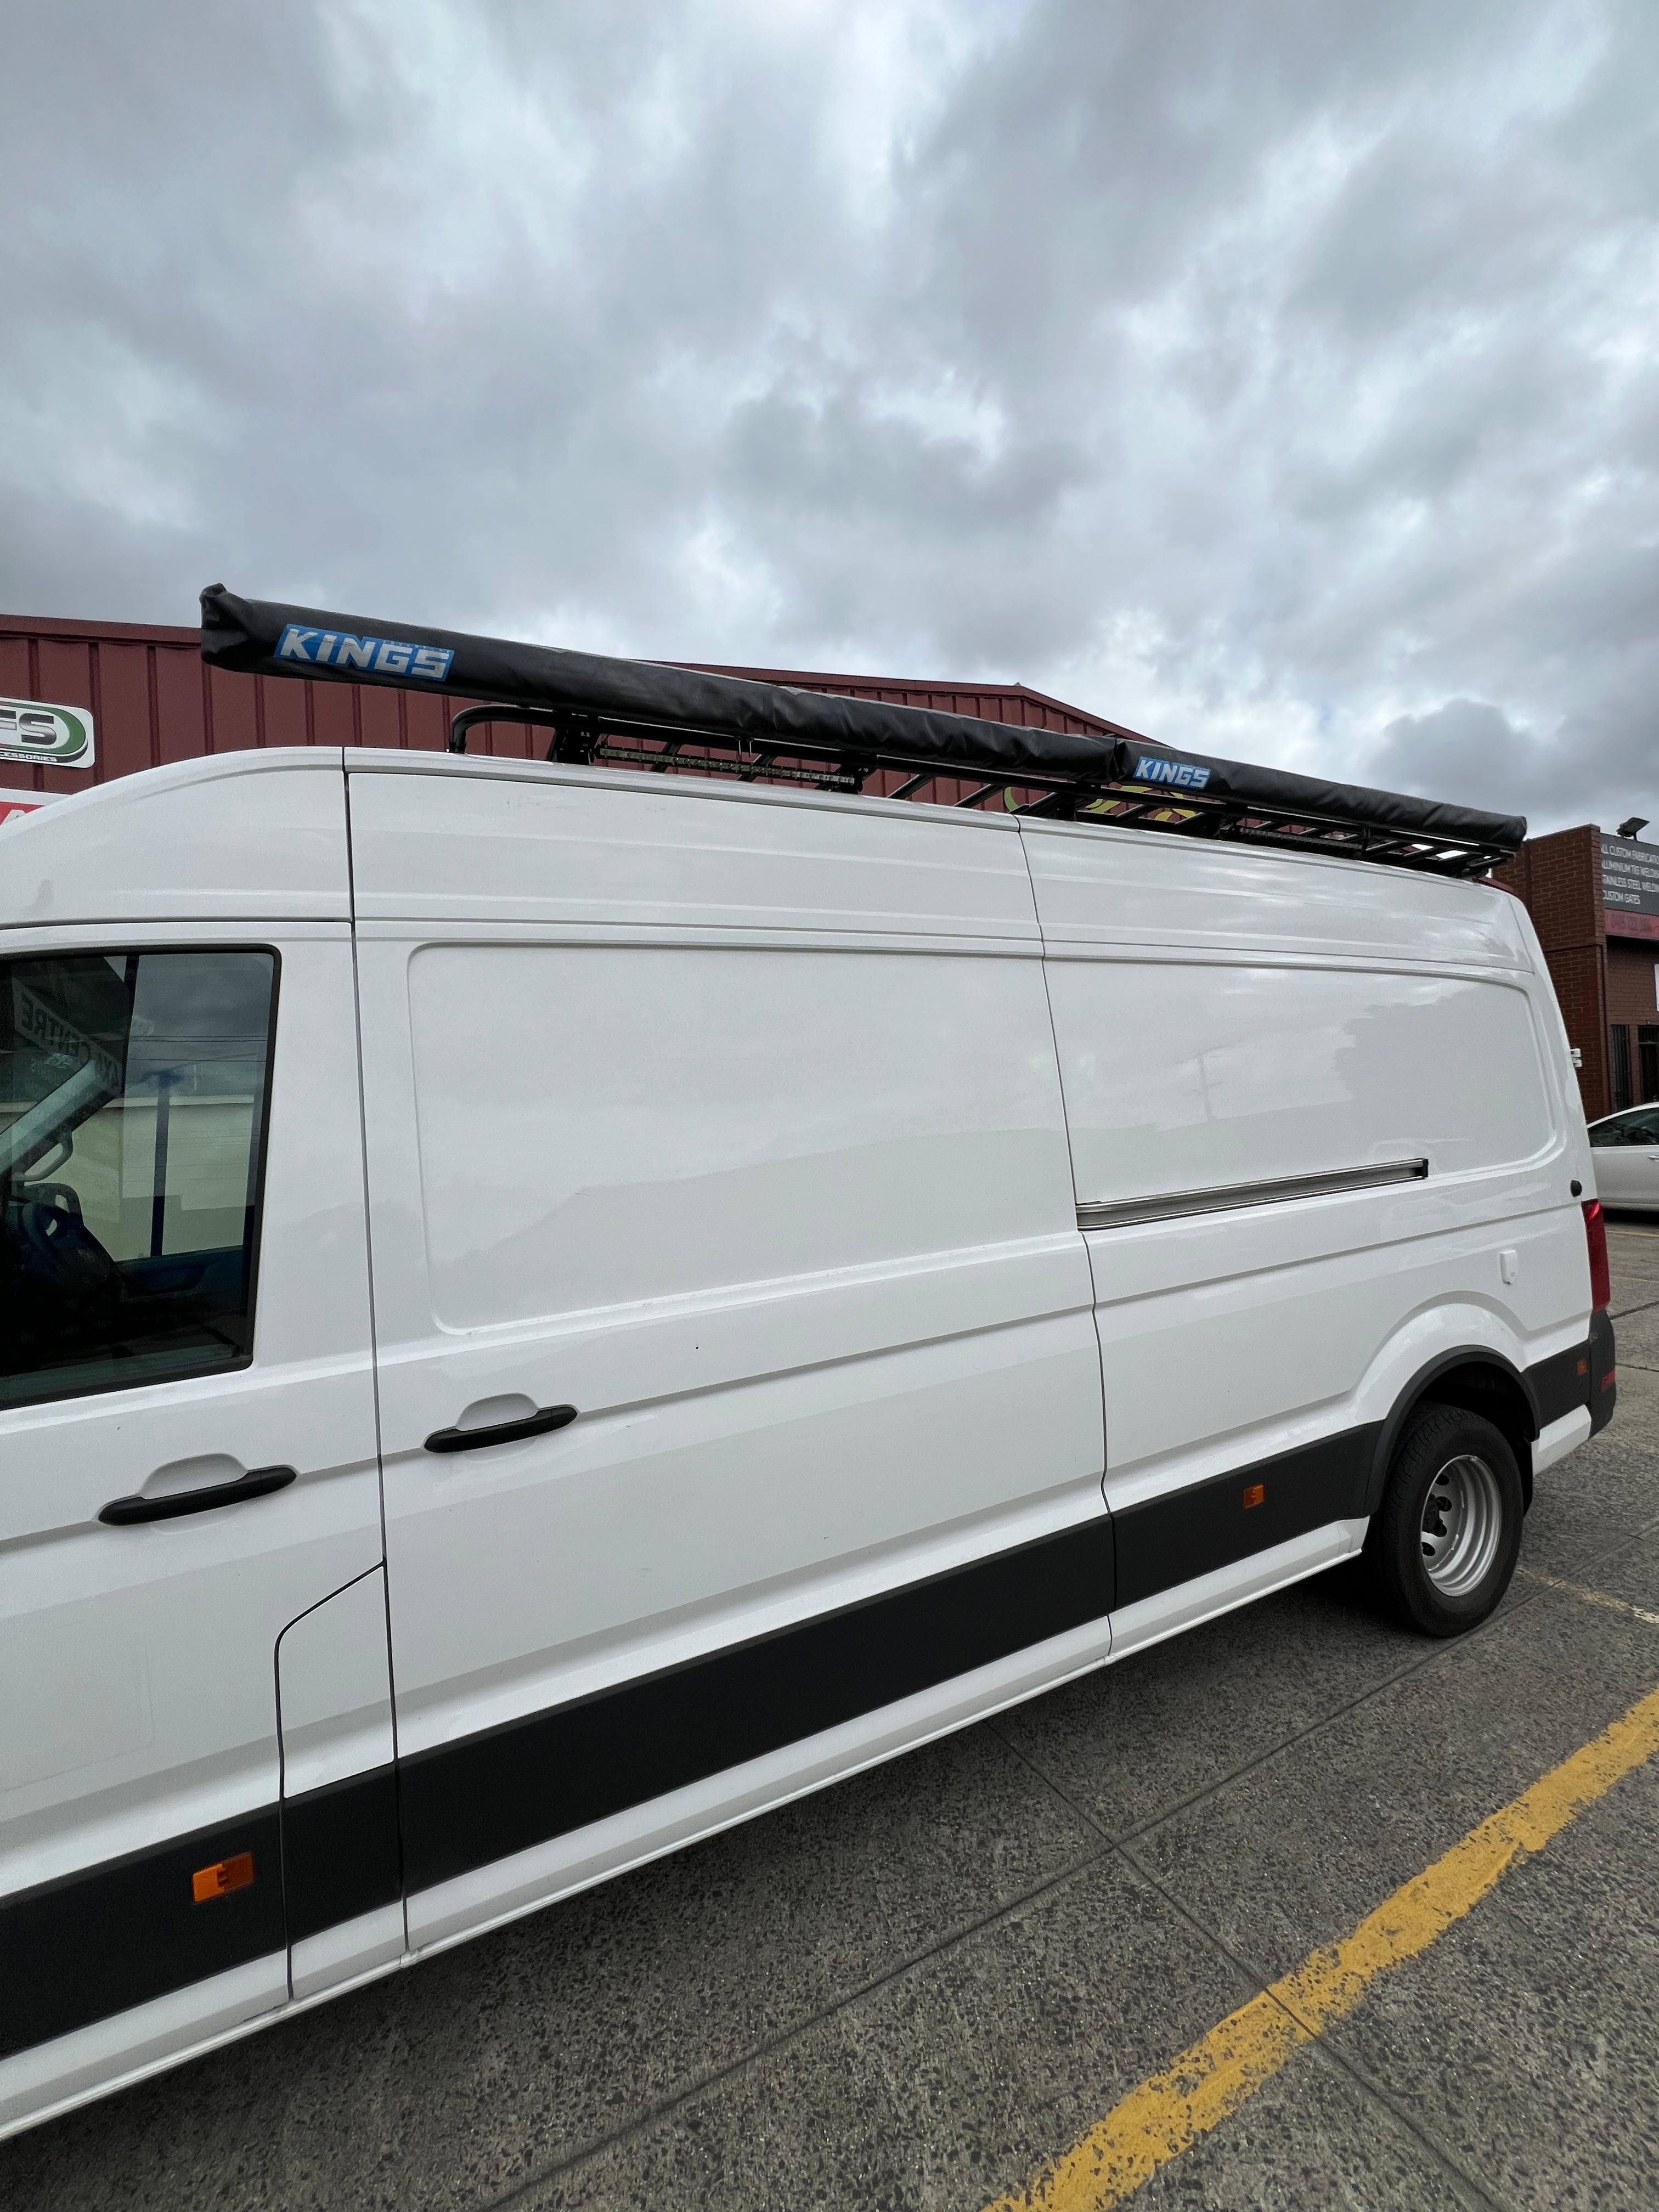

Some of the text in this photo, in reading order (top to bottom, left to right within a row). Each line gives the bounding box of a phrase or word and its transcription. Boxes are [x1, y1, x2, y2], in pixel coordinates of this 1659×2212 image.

[280, 628, 450, 679] KINGS
[1136, 759, 1208, 788] KINGS
[1627, 878, 1641, 890] STEEL
[1624, 893, 1640, 905] GATES
